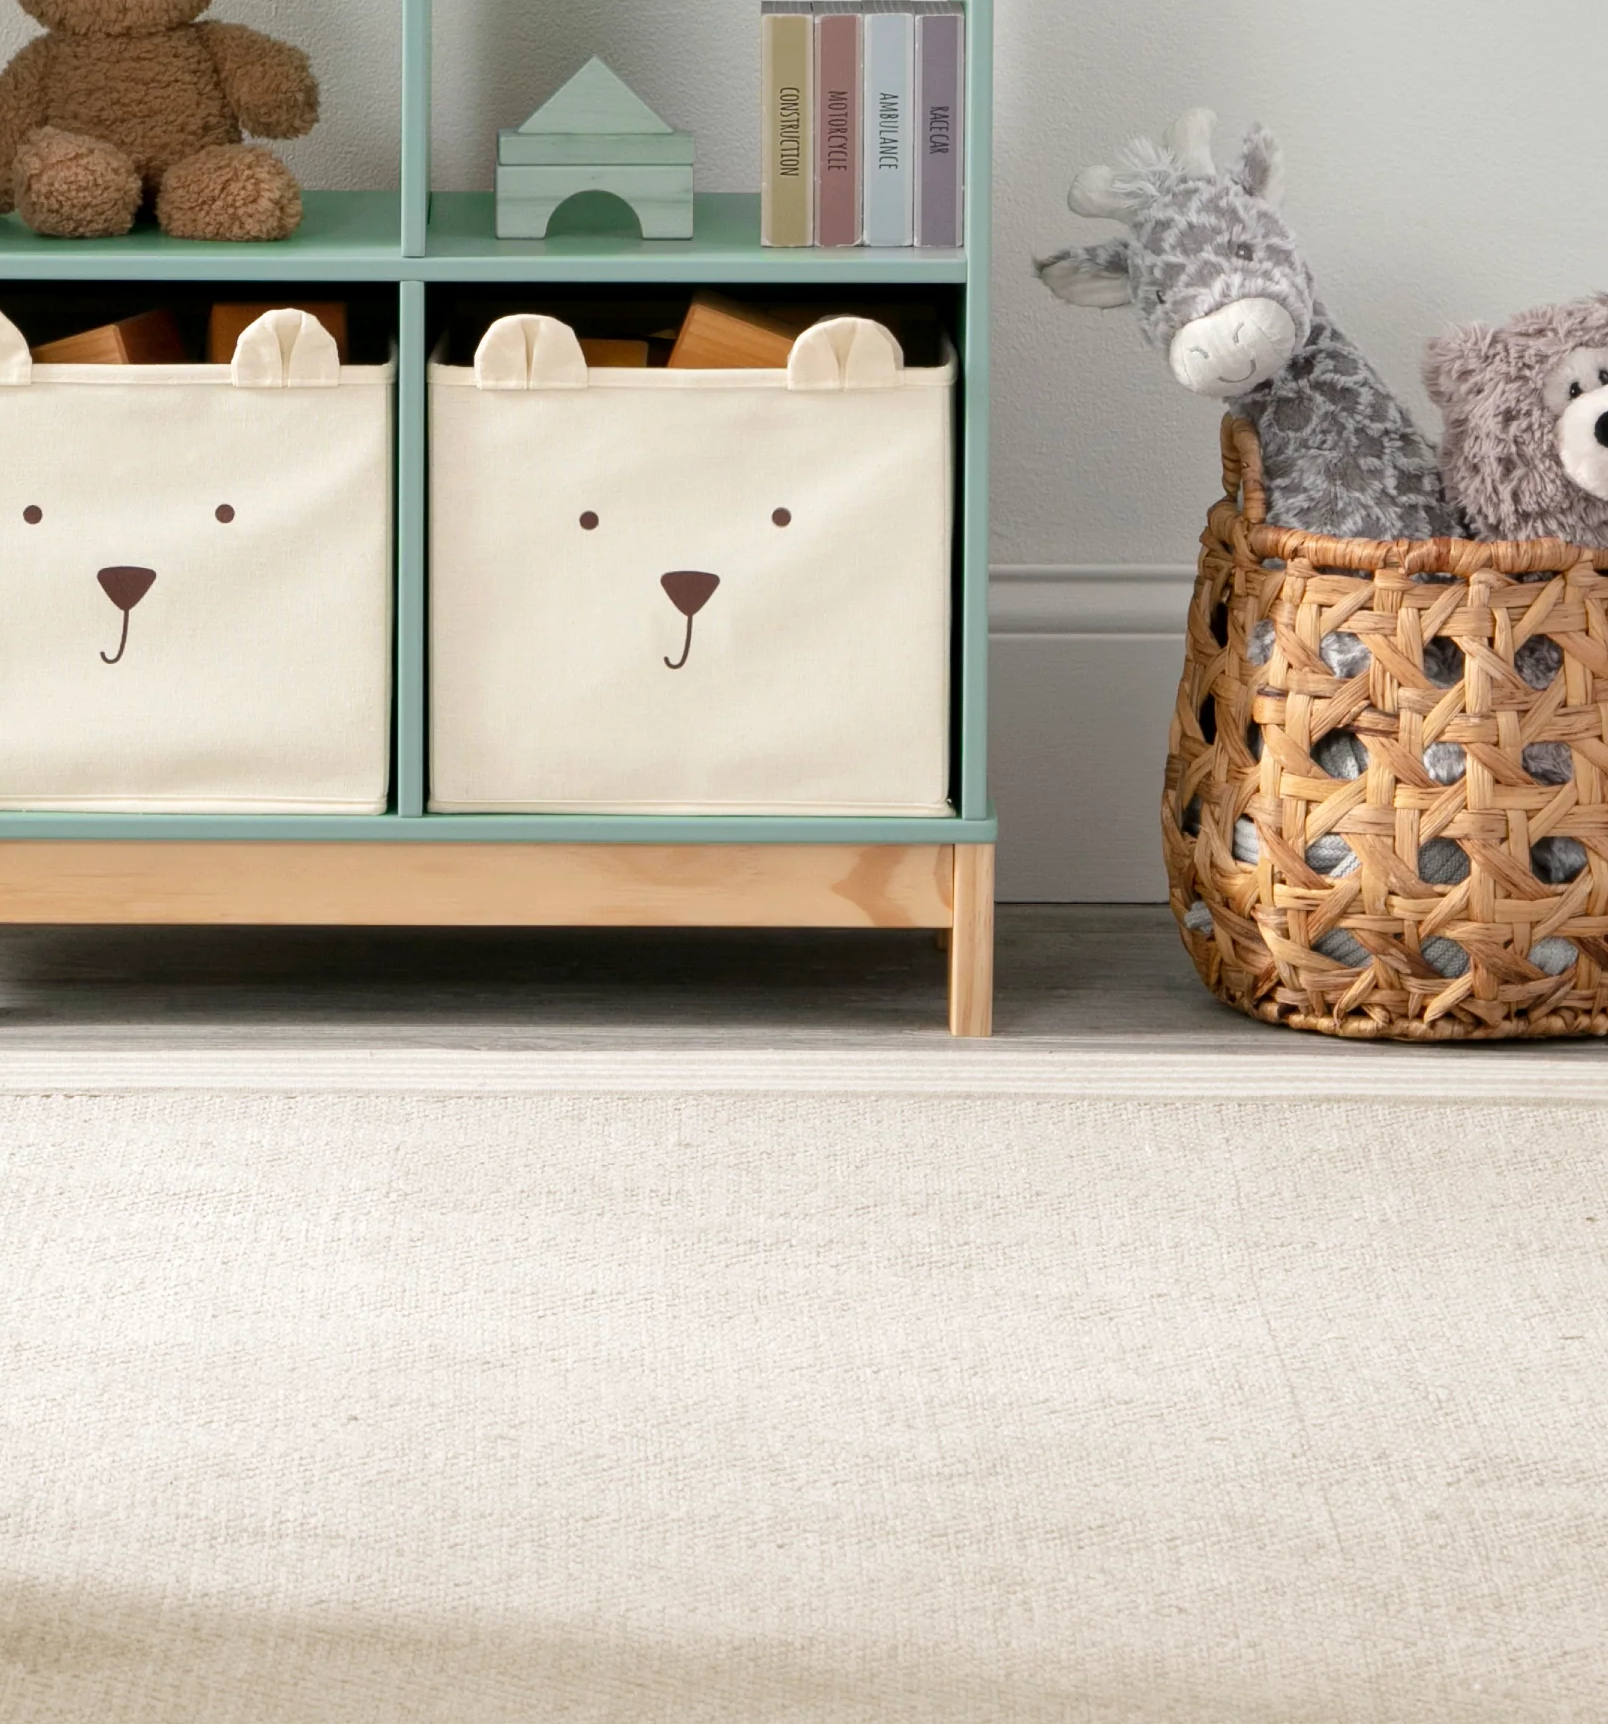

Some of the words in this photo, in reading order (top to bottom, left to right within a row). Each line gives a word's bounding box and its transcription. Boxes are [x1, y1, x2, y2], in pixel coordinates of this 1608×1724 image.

[779, 86, 801, 177] CONSTRUCTION
[827, 90, 849, 172] MOTORCYCLE
[878, 91, 899, 170] AMBULANCE
